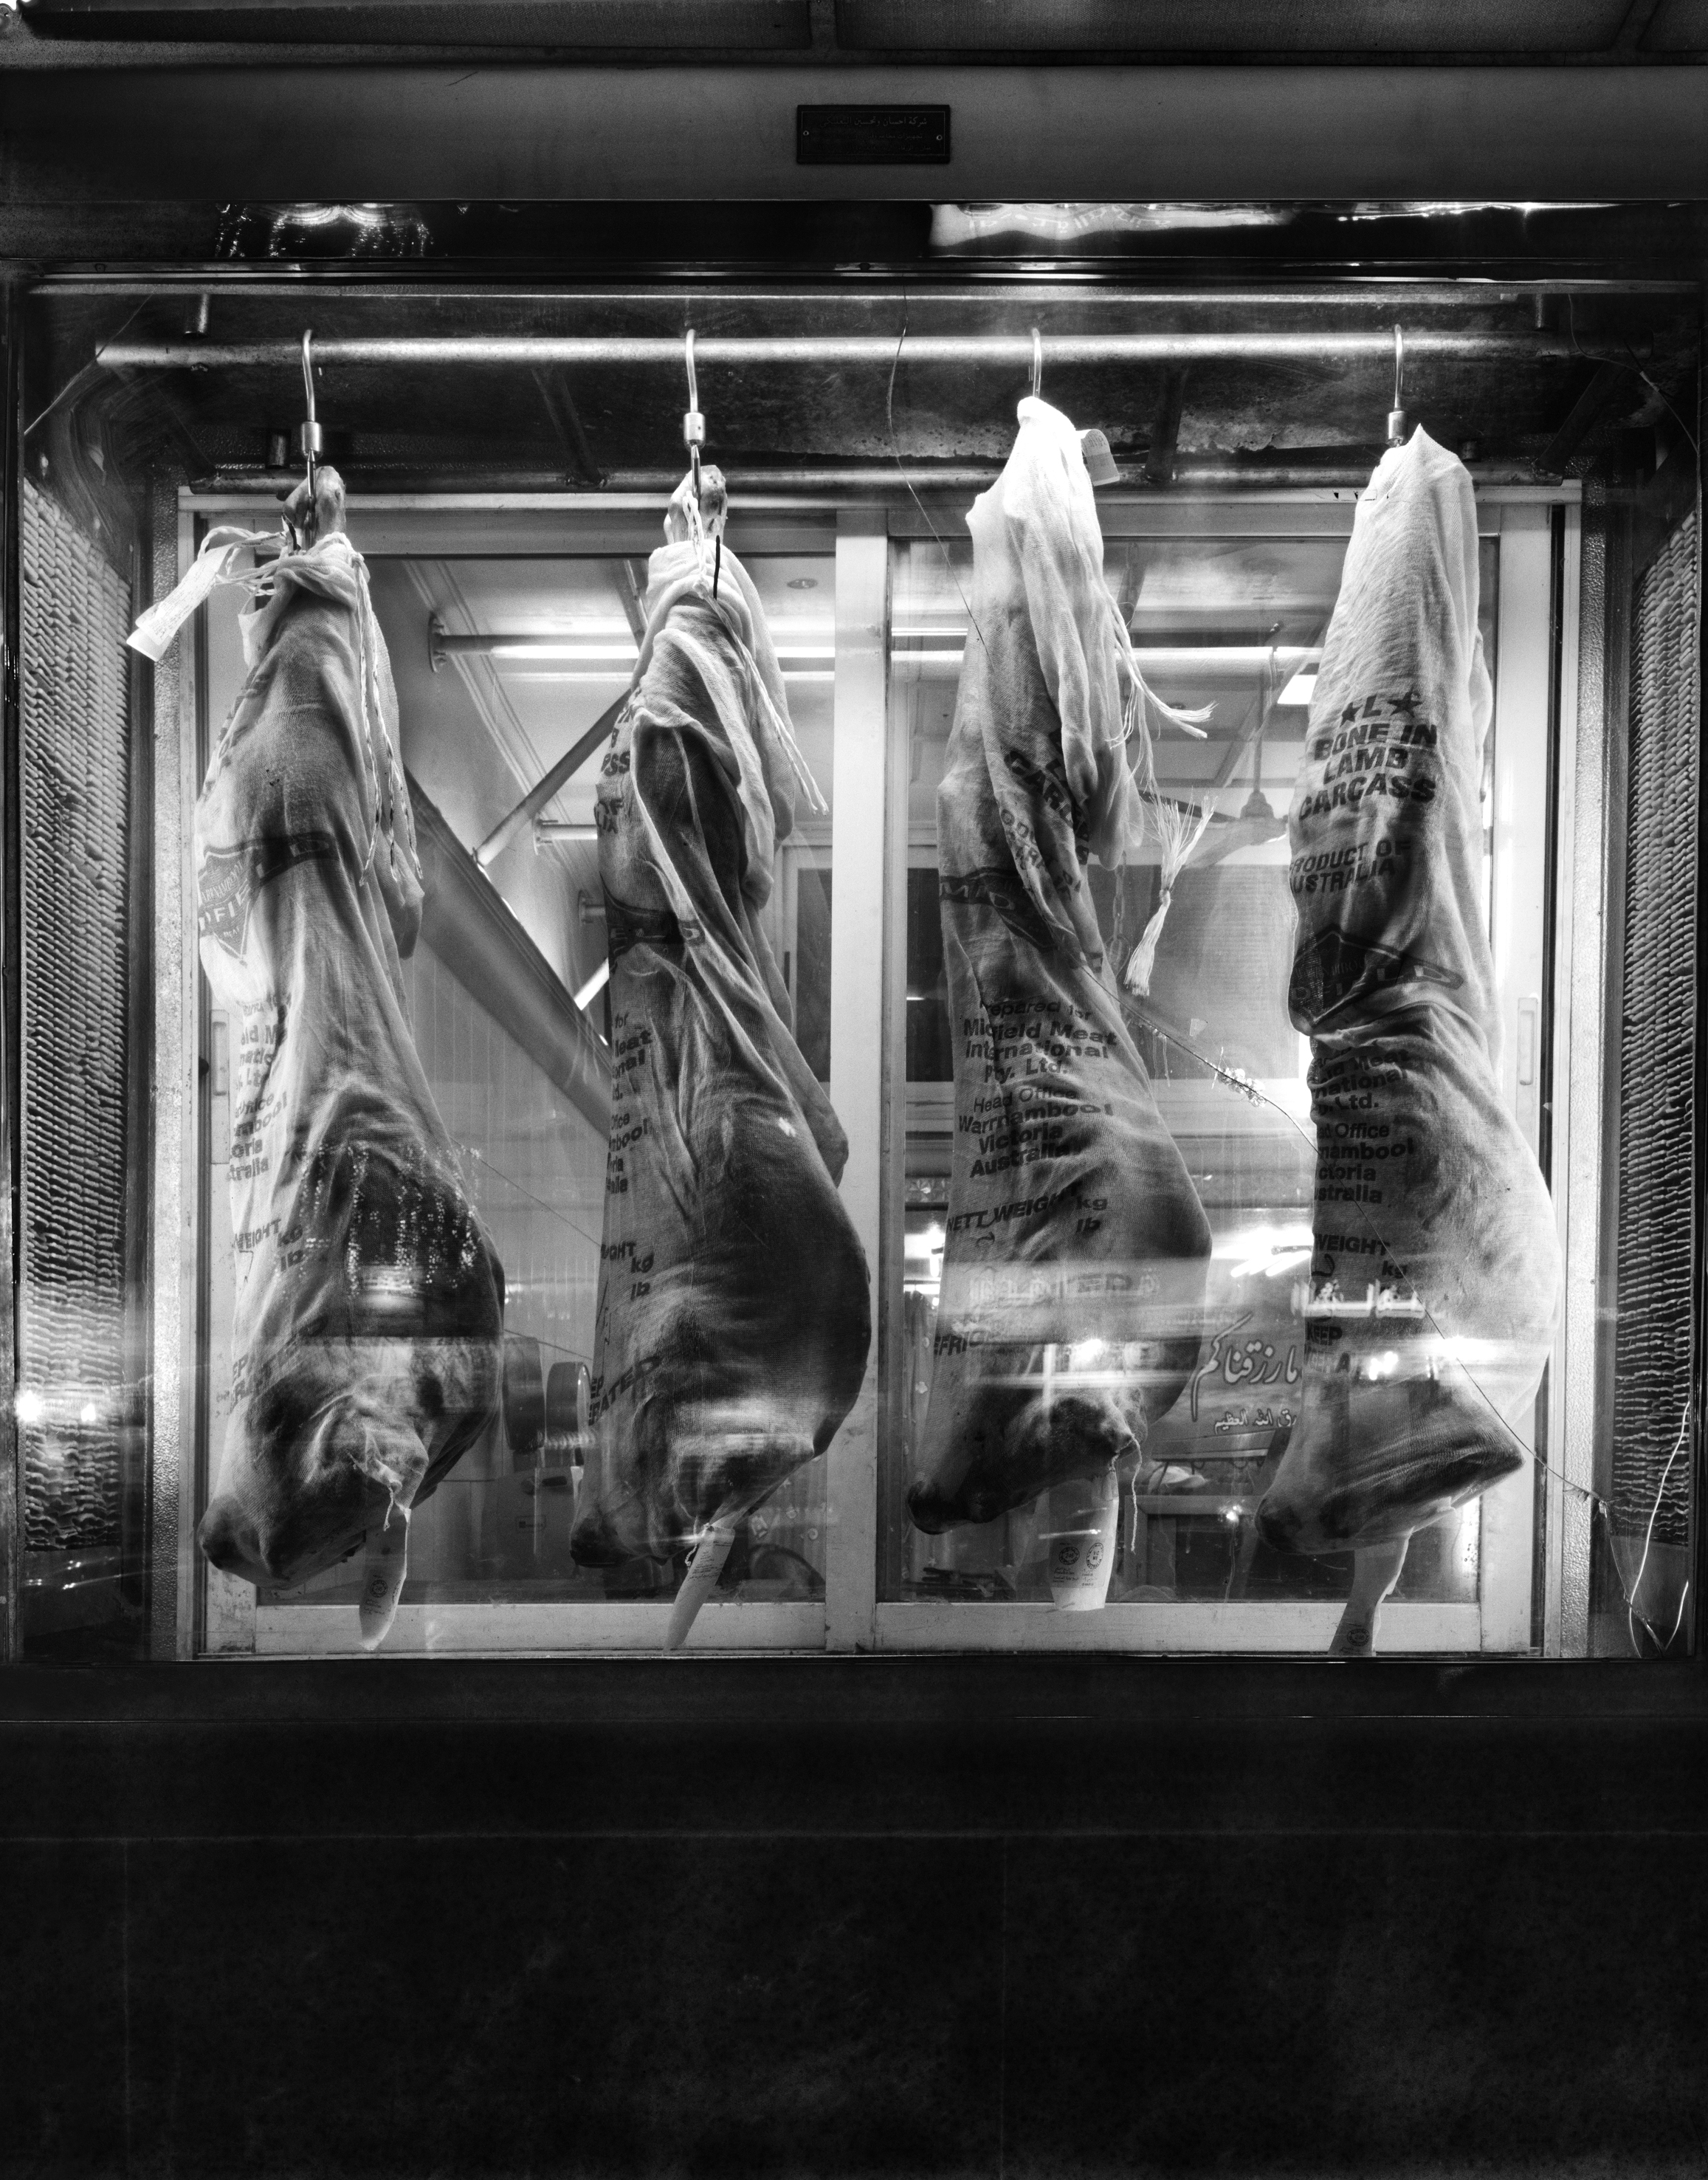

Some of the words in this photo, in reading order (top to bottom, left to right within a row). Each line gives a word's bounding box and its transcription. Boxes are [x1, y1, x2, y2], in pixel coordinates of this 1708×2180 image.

[1314, 723, 1390, 761] BONE
[1399, 723, 1437, 749] IN
[1323, 746, 1408, 785] LAMB
[1298, 773, 1436, 821] CARCASS
[1376, 839, 1411, 856] OF
[1289, 858, 1396, 893] USTRALIA
[1049, 1020, 1118, 1047] Meat
[974, 1092, 1013, 1114] Head
[978, 1122, 1063, 1155] Victoria
[1334, 1122, 1391, 1139] Office
[969, 1142, 1071, 1178] Australia
